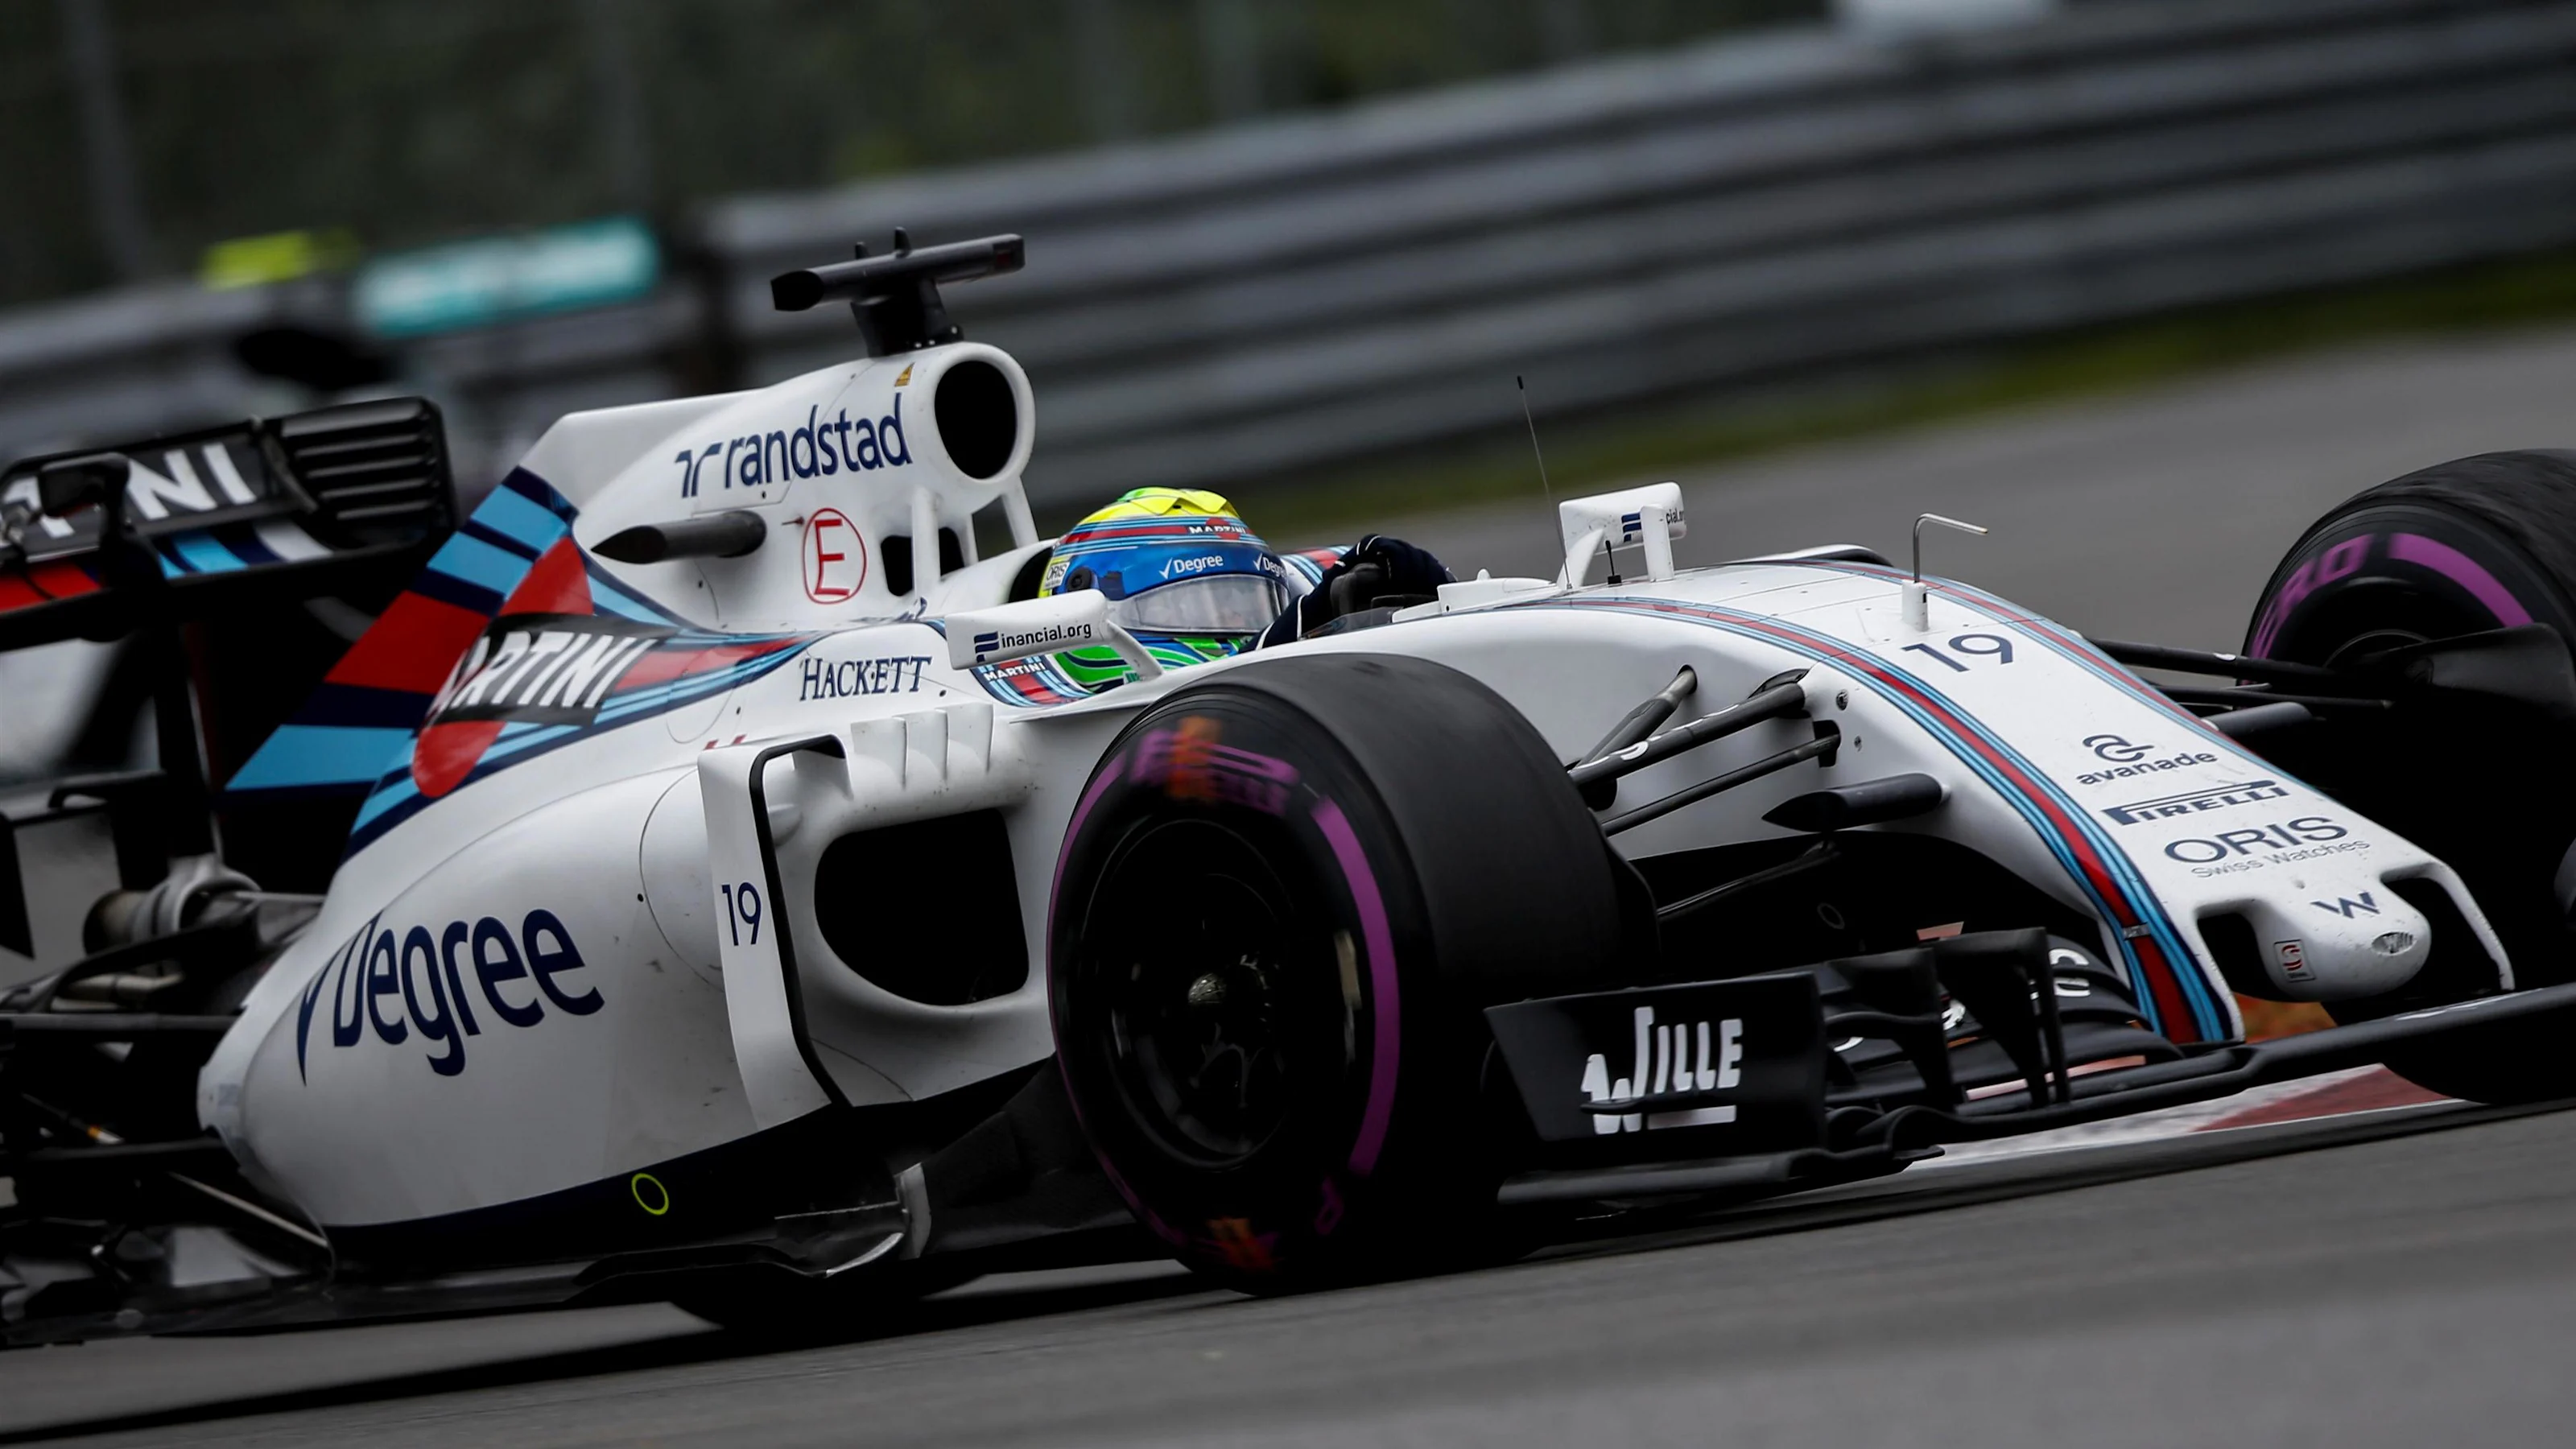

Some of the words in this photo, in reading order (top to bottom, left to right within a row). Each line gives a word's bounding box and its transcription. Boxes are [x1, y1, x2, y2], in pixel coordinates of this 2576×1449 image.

[724, 393, 912, 489] randstad
[1174, 555, 1224, 574] Degree
[983, 662, 1046, 681] MARTINI
[1900, 634, 2013, 673] 19
[799, 655, 932, 702] HACKETT
[2076, 751, 2219, 786] avanade
[2100, 779, 2290, 826] PIRELLI
[2164, 816, 2348, 864] ORIS
[2190, 861, 2264, 878] Swiss
[2264, 838, 2371, 867] Watches
[721, 881, 762, 947] 19
[333, 908, 605, 1077] Degree
